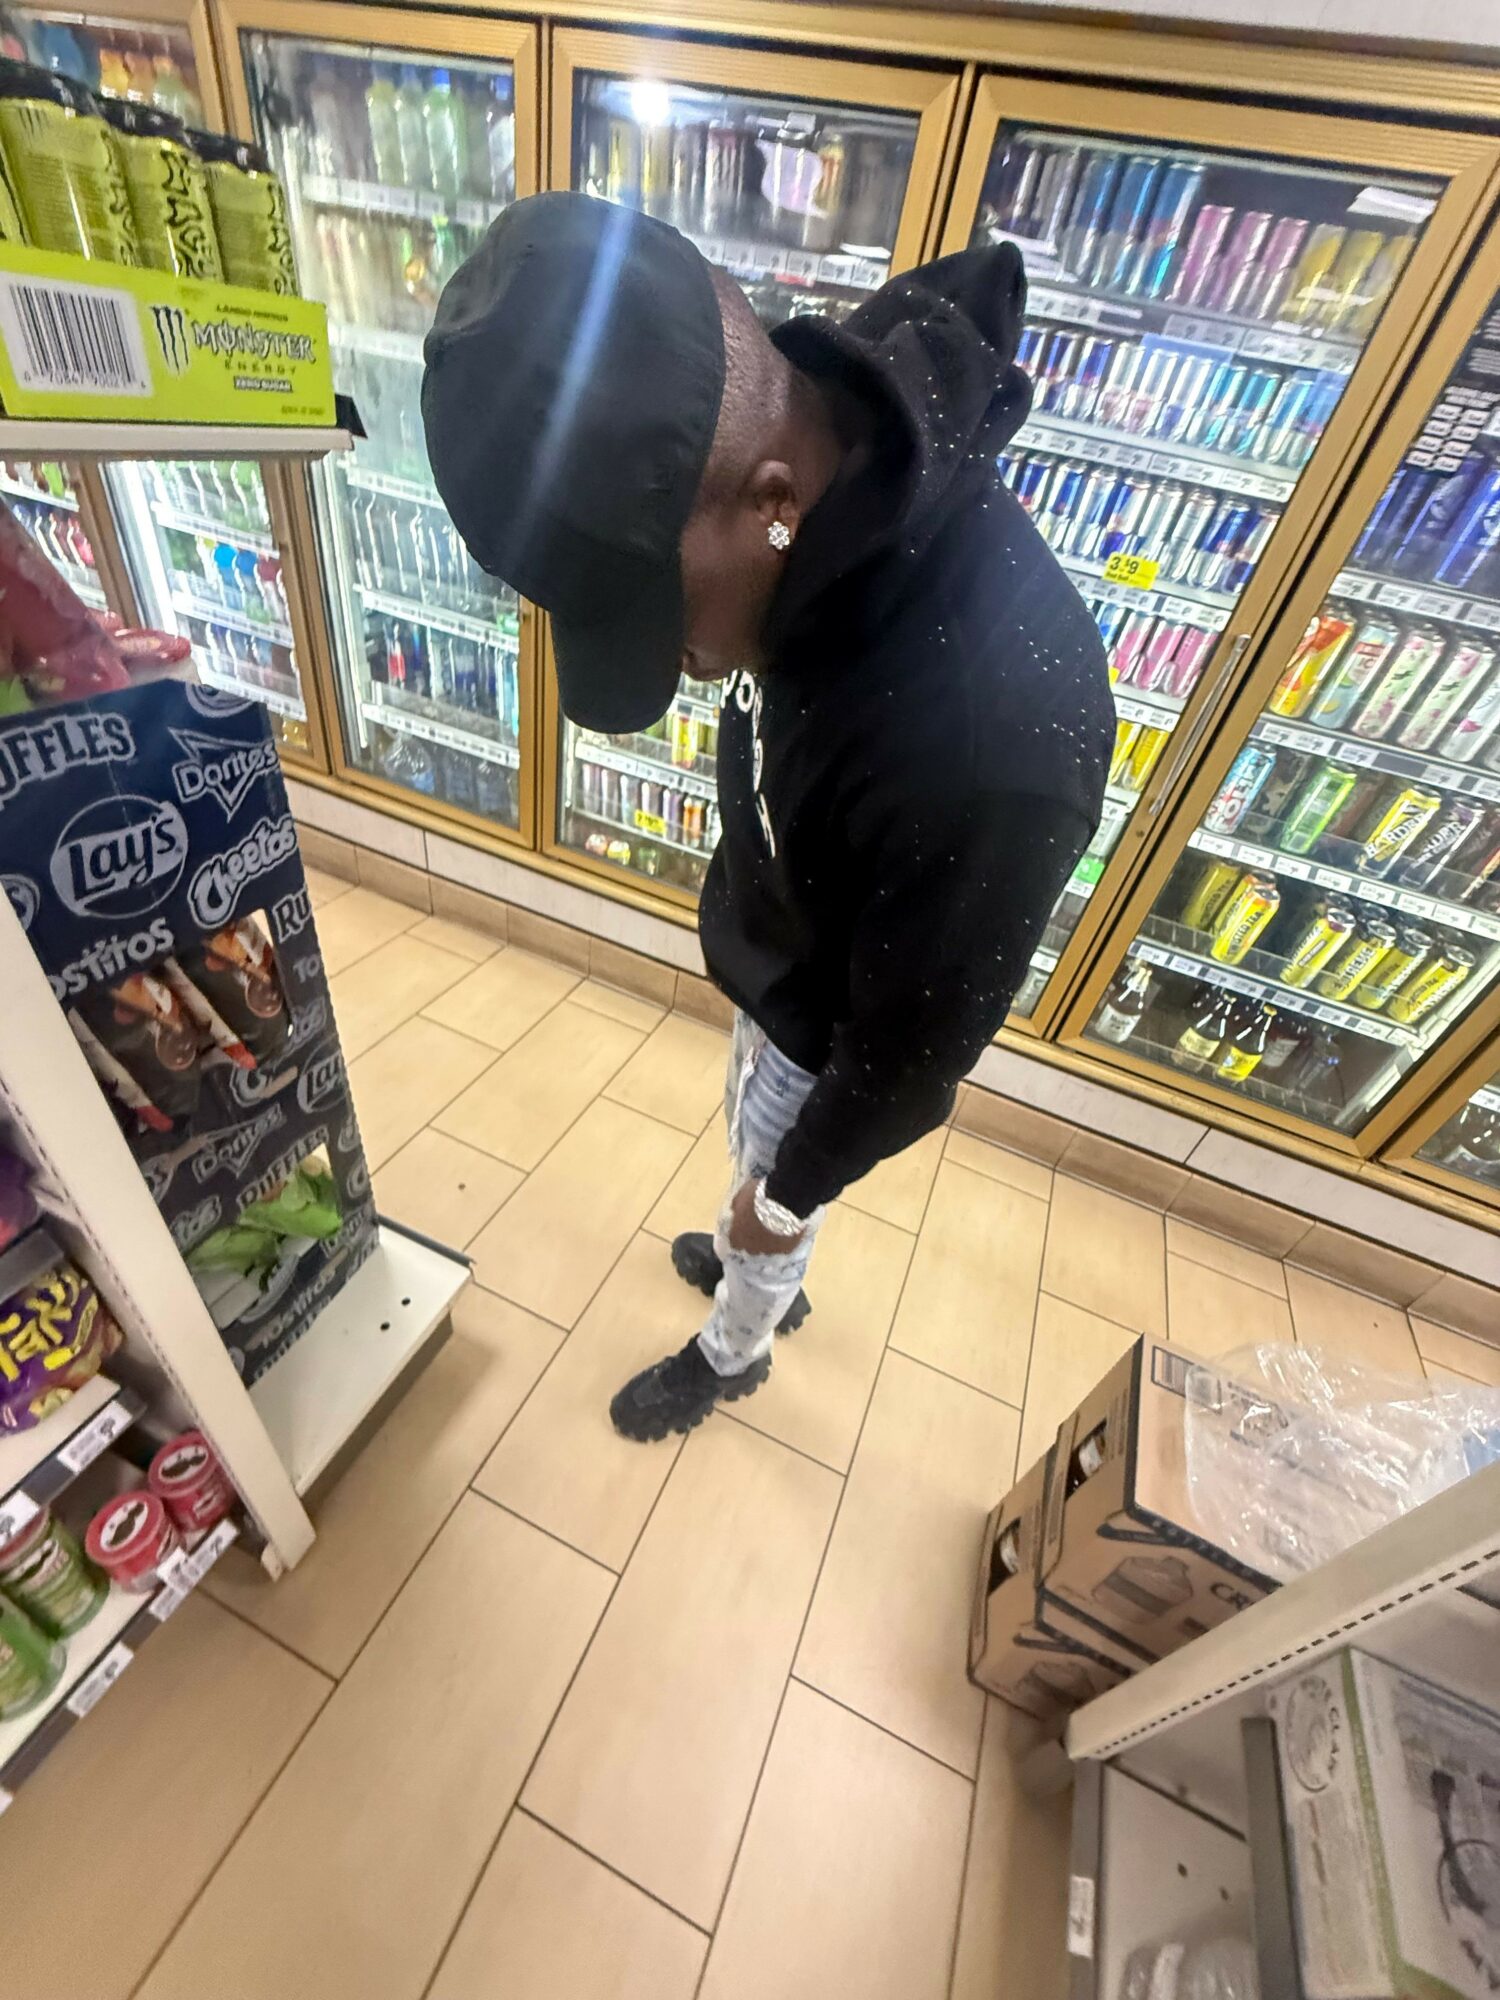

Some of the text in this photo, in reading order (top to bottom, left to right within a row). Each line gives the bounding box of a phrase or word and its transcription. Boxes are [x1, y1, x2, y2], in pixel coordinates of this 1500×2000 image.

[191, 319, 316, 364] MONSTER
[179, 742, 278, 795] Doritos
[68, 815, 178, 901] Lay's
[191, 818, 297, 927] Cheetos
